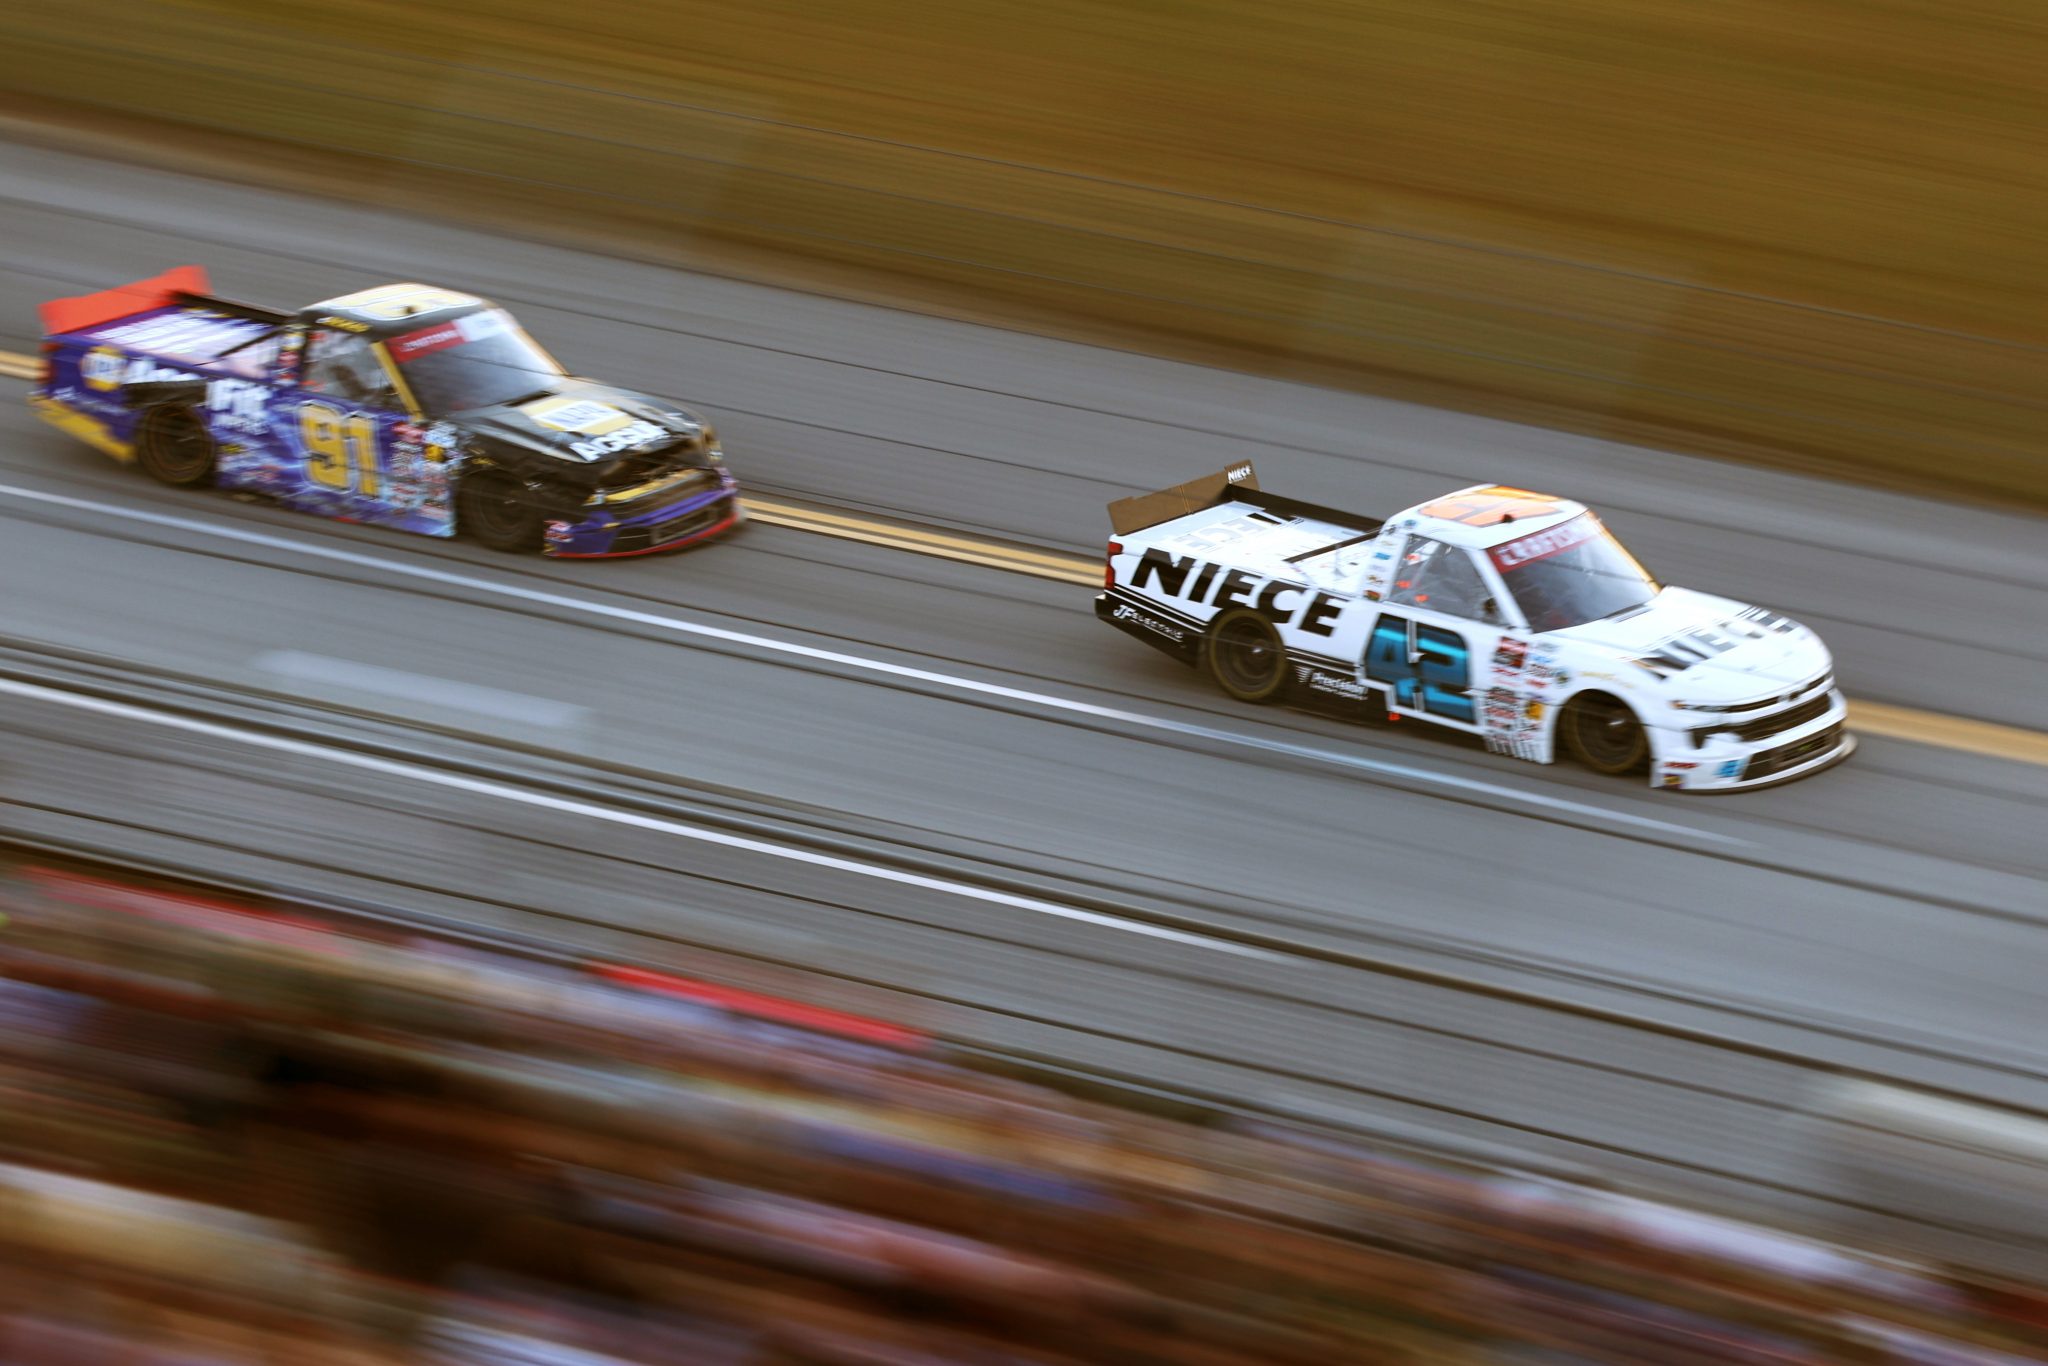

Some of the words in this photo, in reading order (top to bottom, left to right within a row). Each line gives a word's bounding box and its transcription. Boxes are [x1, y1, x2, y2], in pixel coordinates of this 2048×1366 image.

[299, 403, 379, 498] 91
[1130, 547, 1350, 637] NIECE
[1363, 612, 1478, 726] 42
[1631, 609, 1798, 681] NIECE
